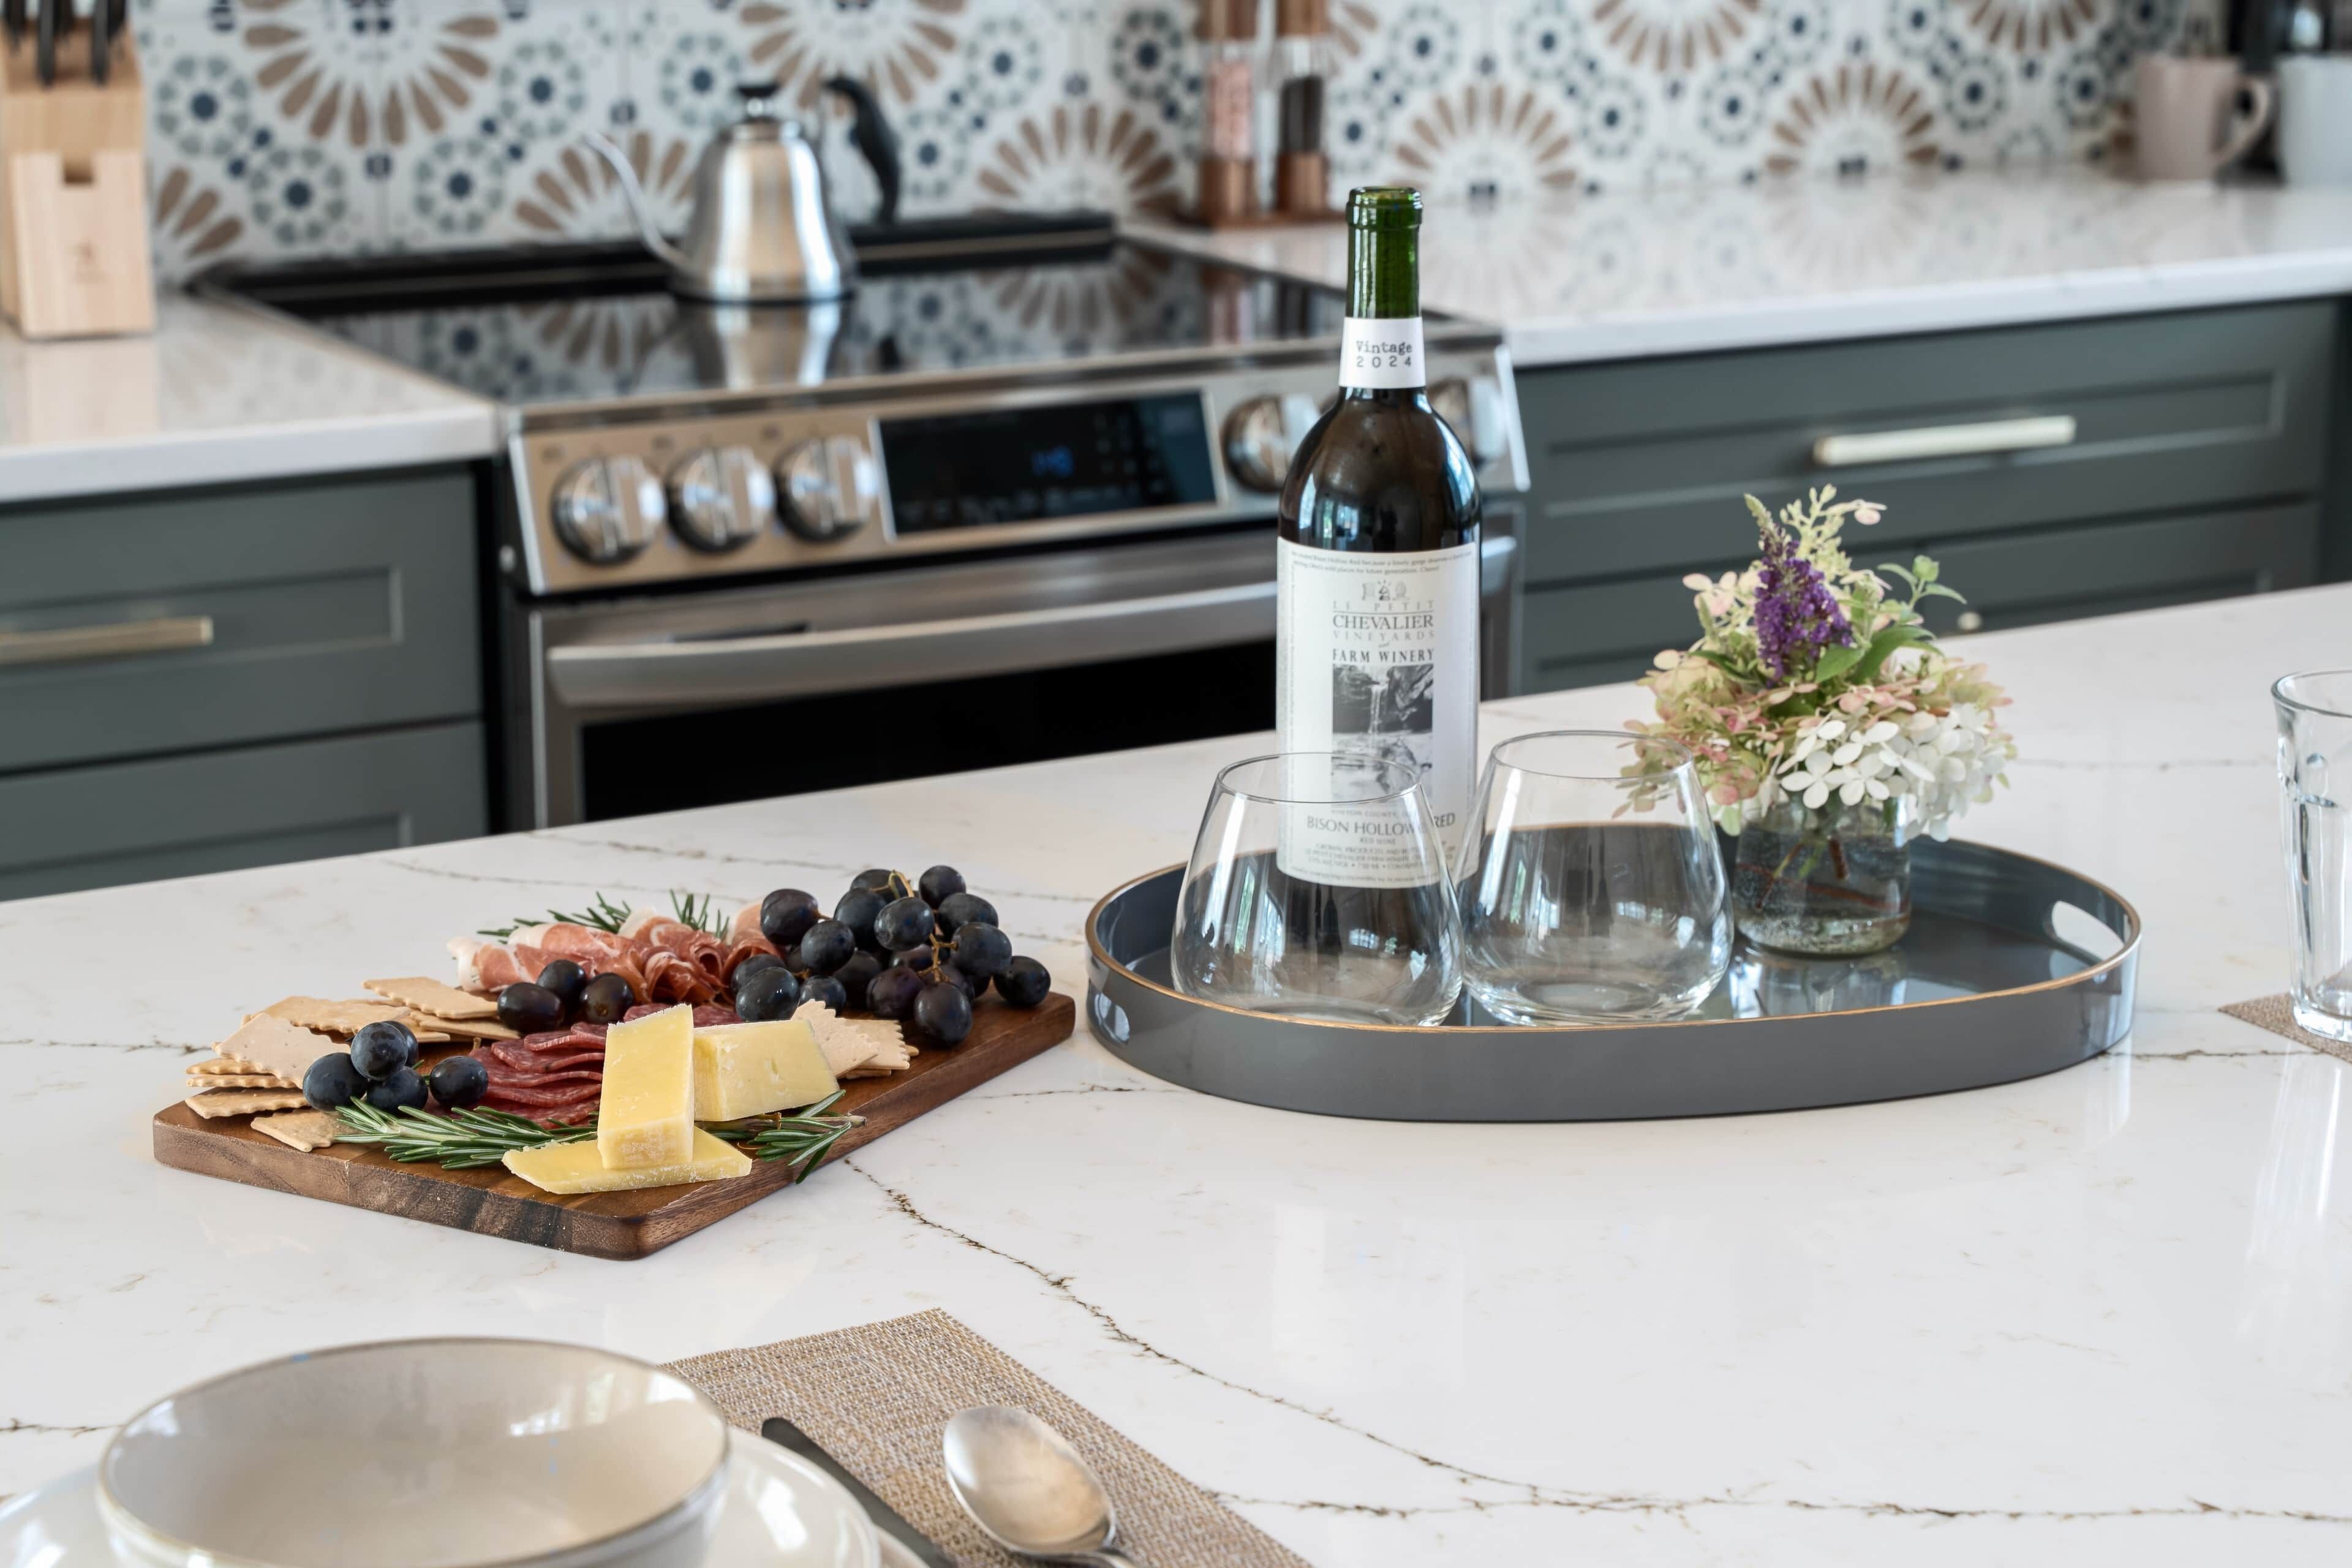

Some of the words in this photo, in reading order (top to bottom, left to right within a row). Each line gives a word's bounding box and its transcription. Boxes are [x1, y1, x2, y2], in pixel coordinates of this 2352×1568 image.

[1356, 341, 1412, 356] Vintage
[1332, 614, 1434, 630] CHEVALIER
[1333, 630, 1435, 641] VINEYARDS
[1332, 648, 1370, 663] FARM
[1378, 648, 1434, 663] WINERY
[1306, 815, 1349, 833] BISON
